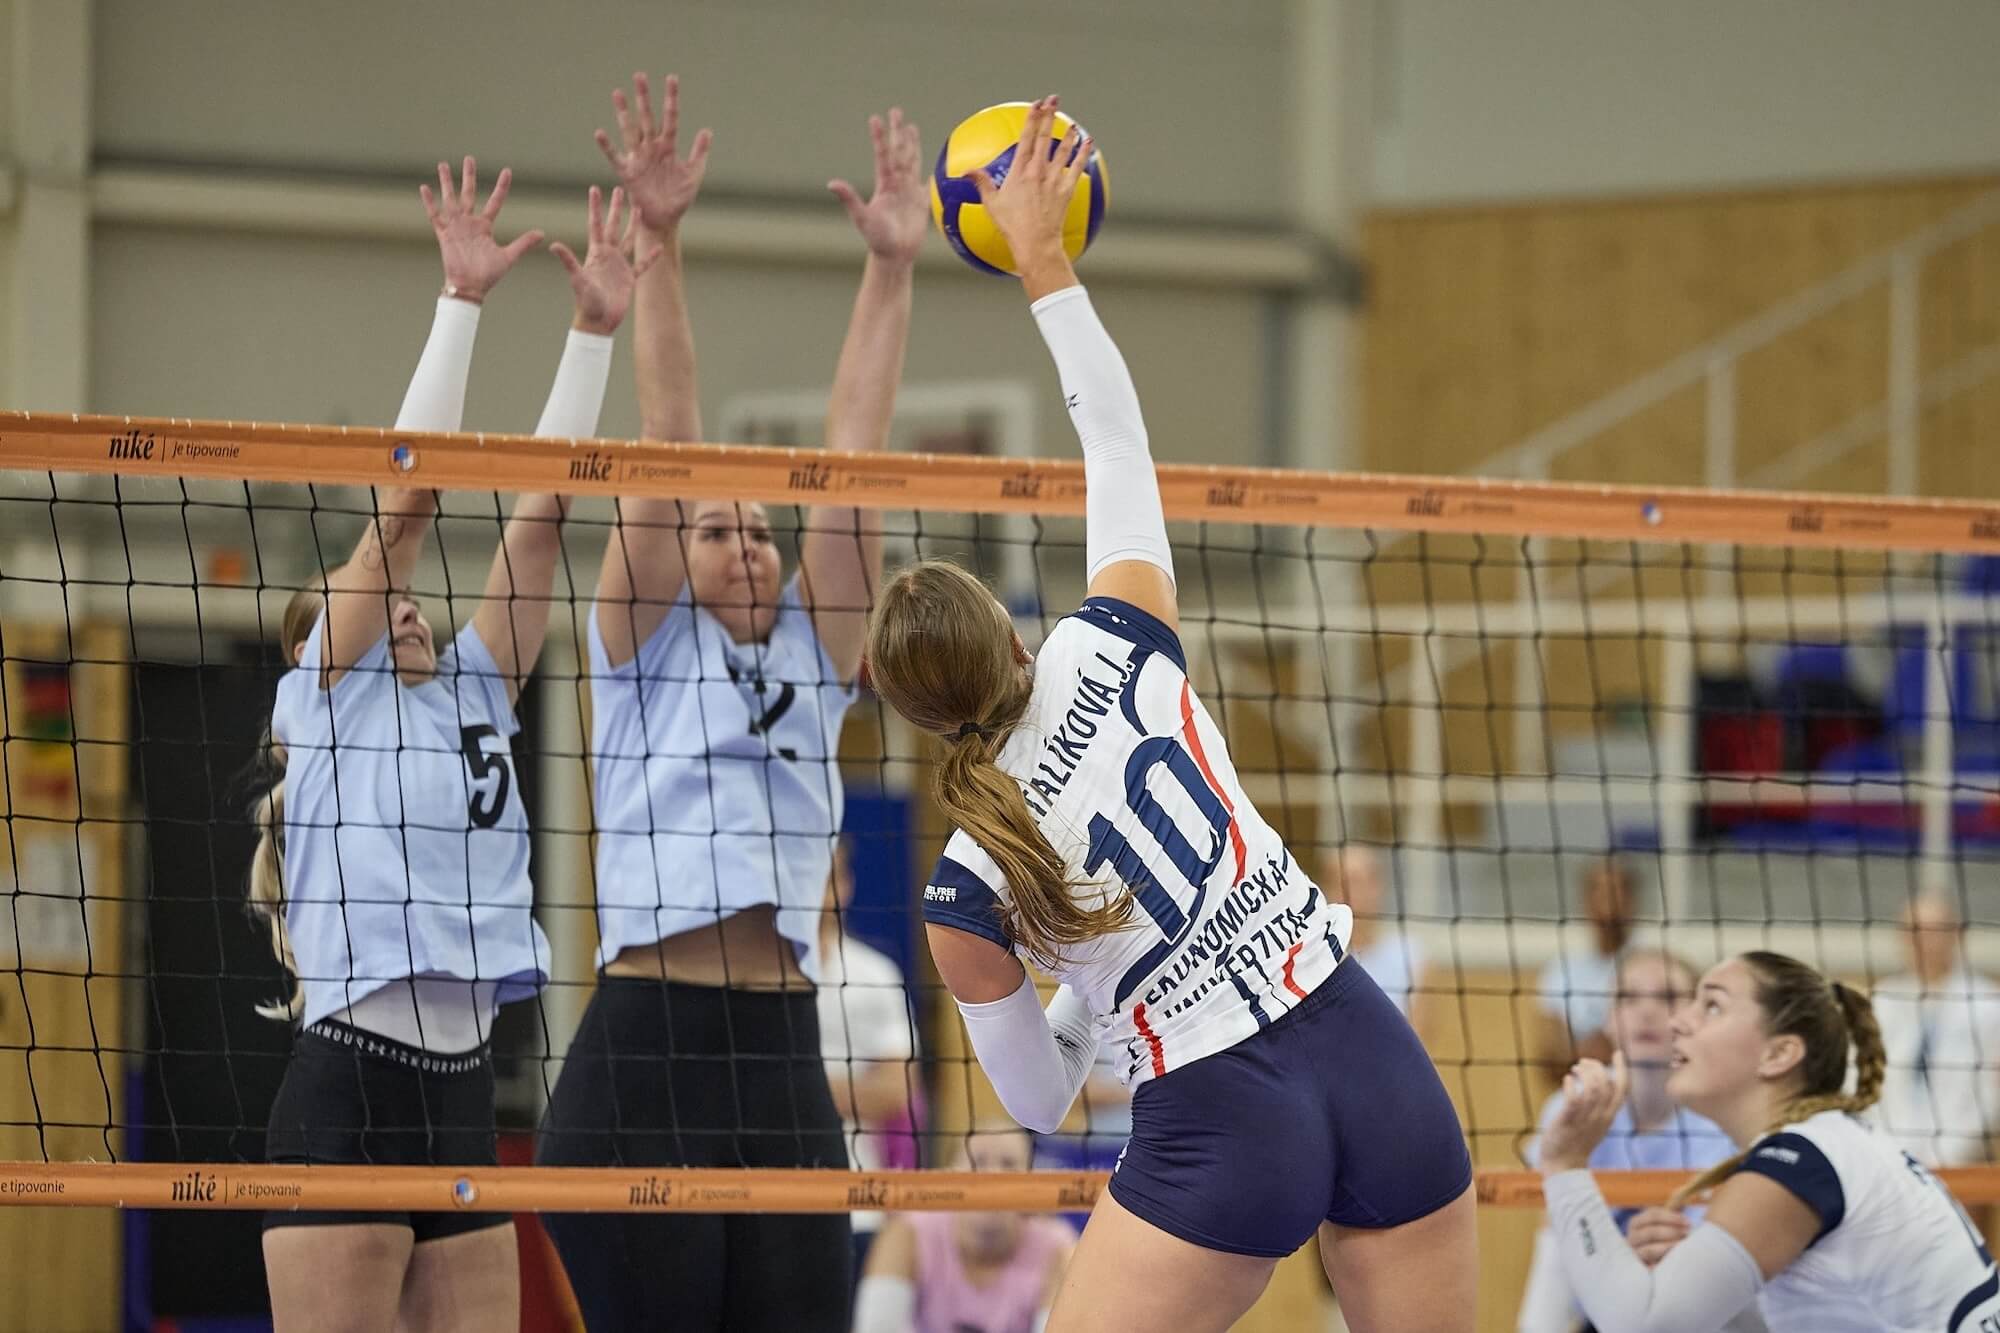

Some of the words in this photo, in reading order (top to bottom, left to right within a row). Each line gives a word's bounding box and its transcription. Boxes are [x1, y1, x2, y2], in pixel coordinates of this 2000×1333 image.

[108, 430, 155, 460] niké
[171, 443, 184, 457] je
[185, 442, 240, 459] tipovanie
[569, 452, 612, 481] niké
[1095, 652, 1132, 681] J.
[461, 723, 510, 829] 5
[1083, 736, 1231, 942] 10
[9, 1179, 65, 1194] tipovanie
[172, 1171, 217, 1202] niké
[235, 1181, 247, 1197] je
[248, 1179, 302, 1198] tipovanie
[629, 1176, 671, 1206] niké
